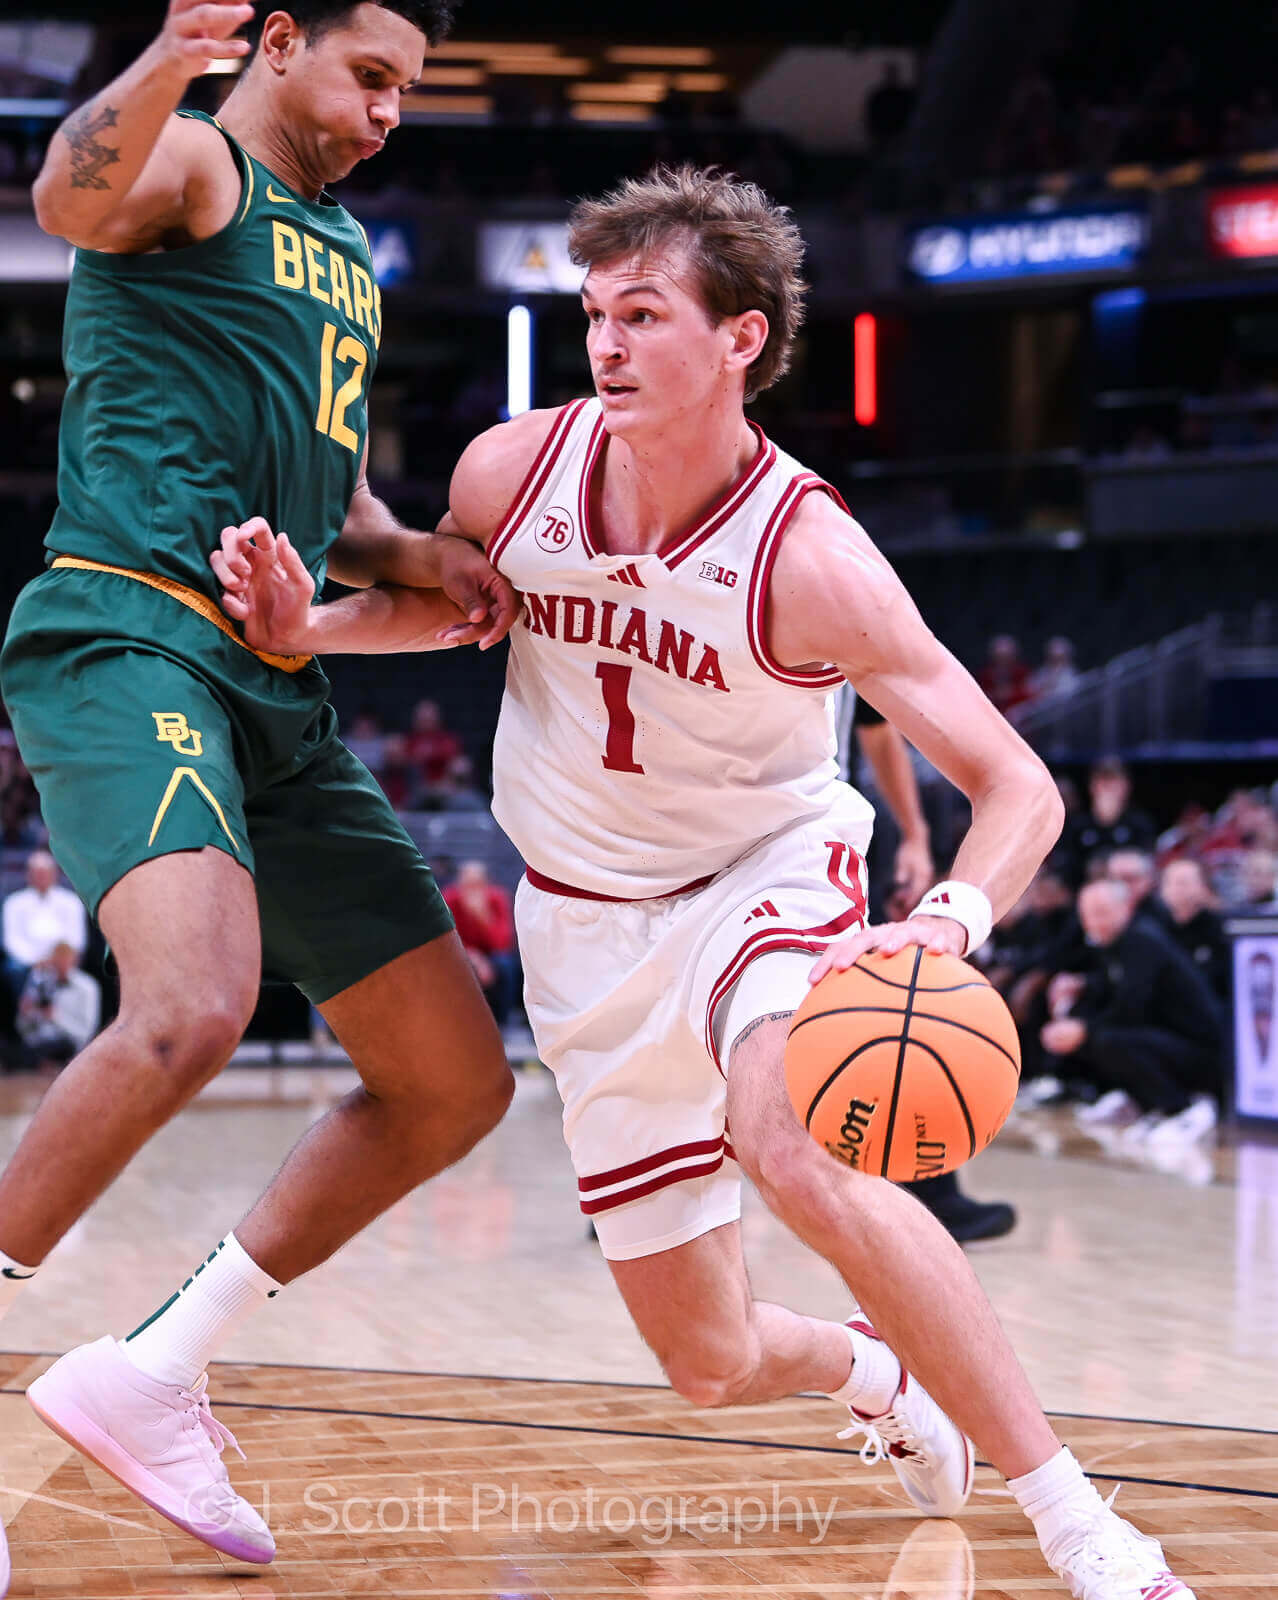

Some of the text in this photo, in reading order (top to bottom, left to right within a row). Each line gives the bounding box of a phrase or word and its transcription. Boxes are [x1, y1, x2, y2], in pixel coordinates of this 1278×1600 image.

[315, 322, 368, 454] 12
[151, 712, 203, 756] BU
[595, 661, 645, 775] 1
